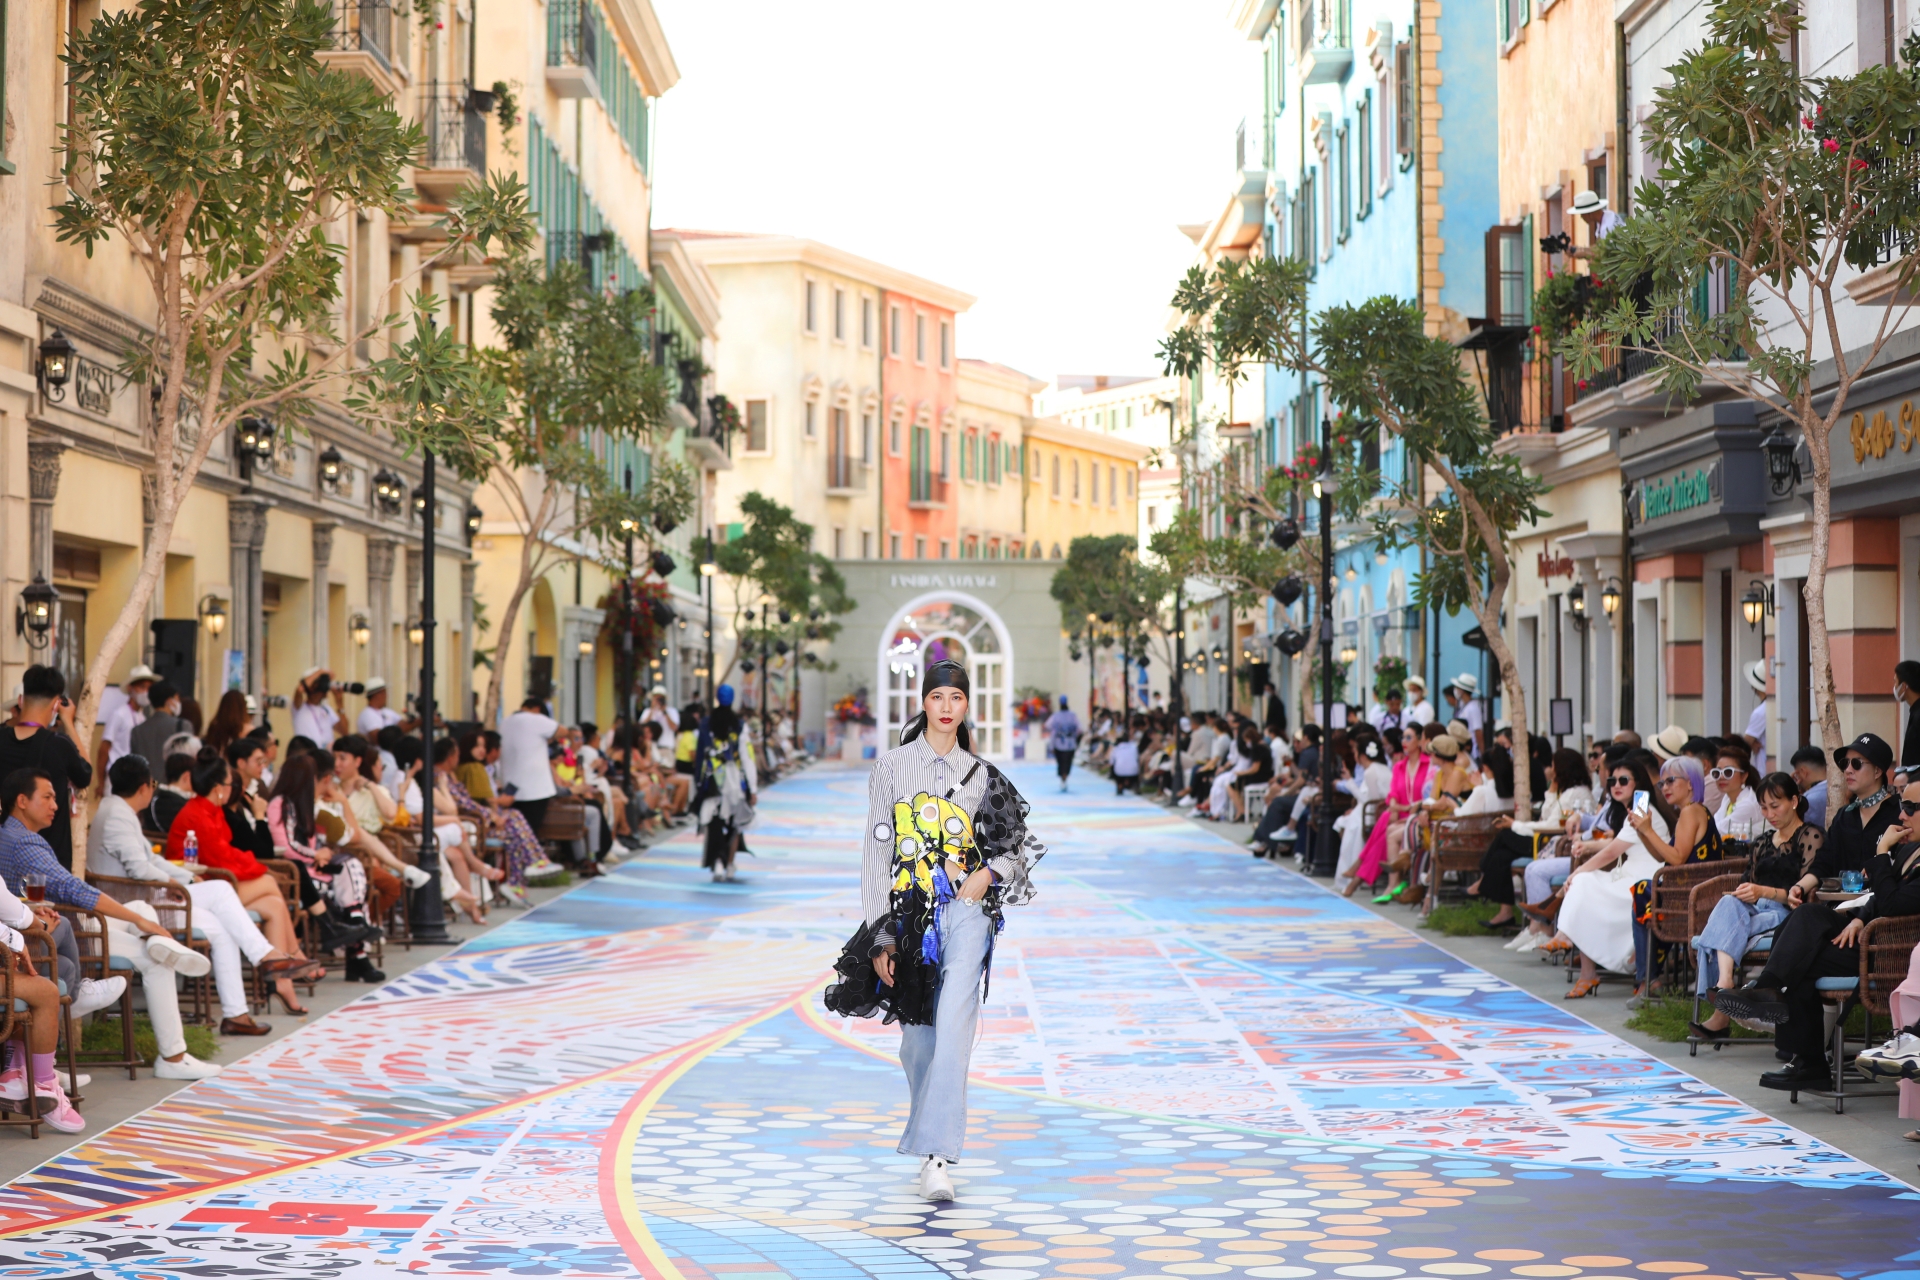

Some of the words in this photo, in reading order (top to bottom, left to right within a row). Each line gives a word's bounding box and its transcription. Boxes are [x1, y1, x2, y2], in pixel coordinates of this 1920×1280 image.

[1645, 477, 1671, 520] Venice
[1672, 469, 1695, 513] Juice
[1695, 468, 1709, 507] Bar
